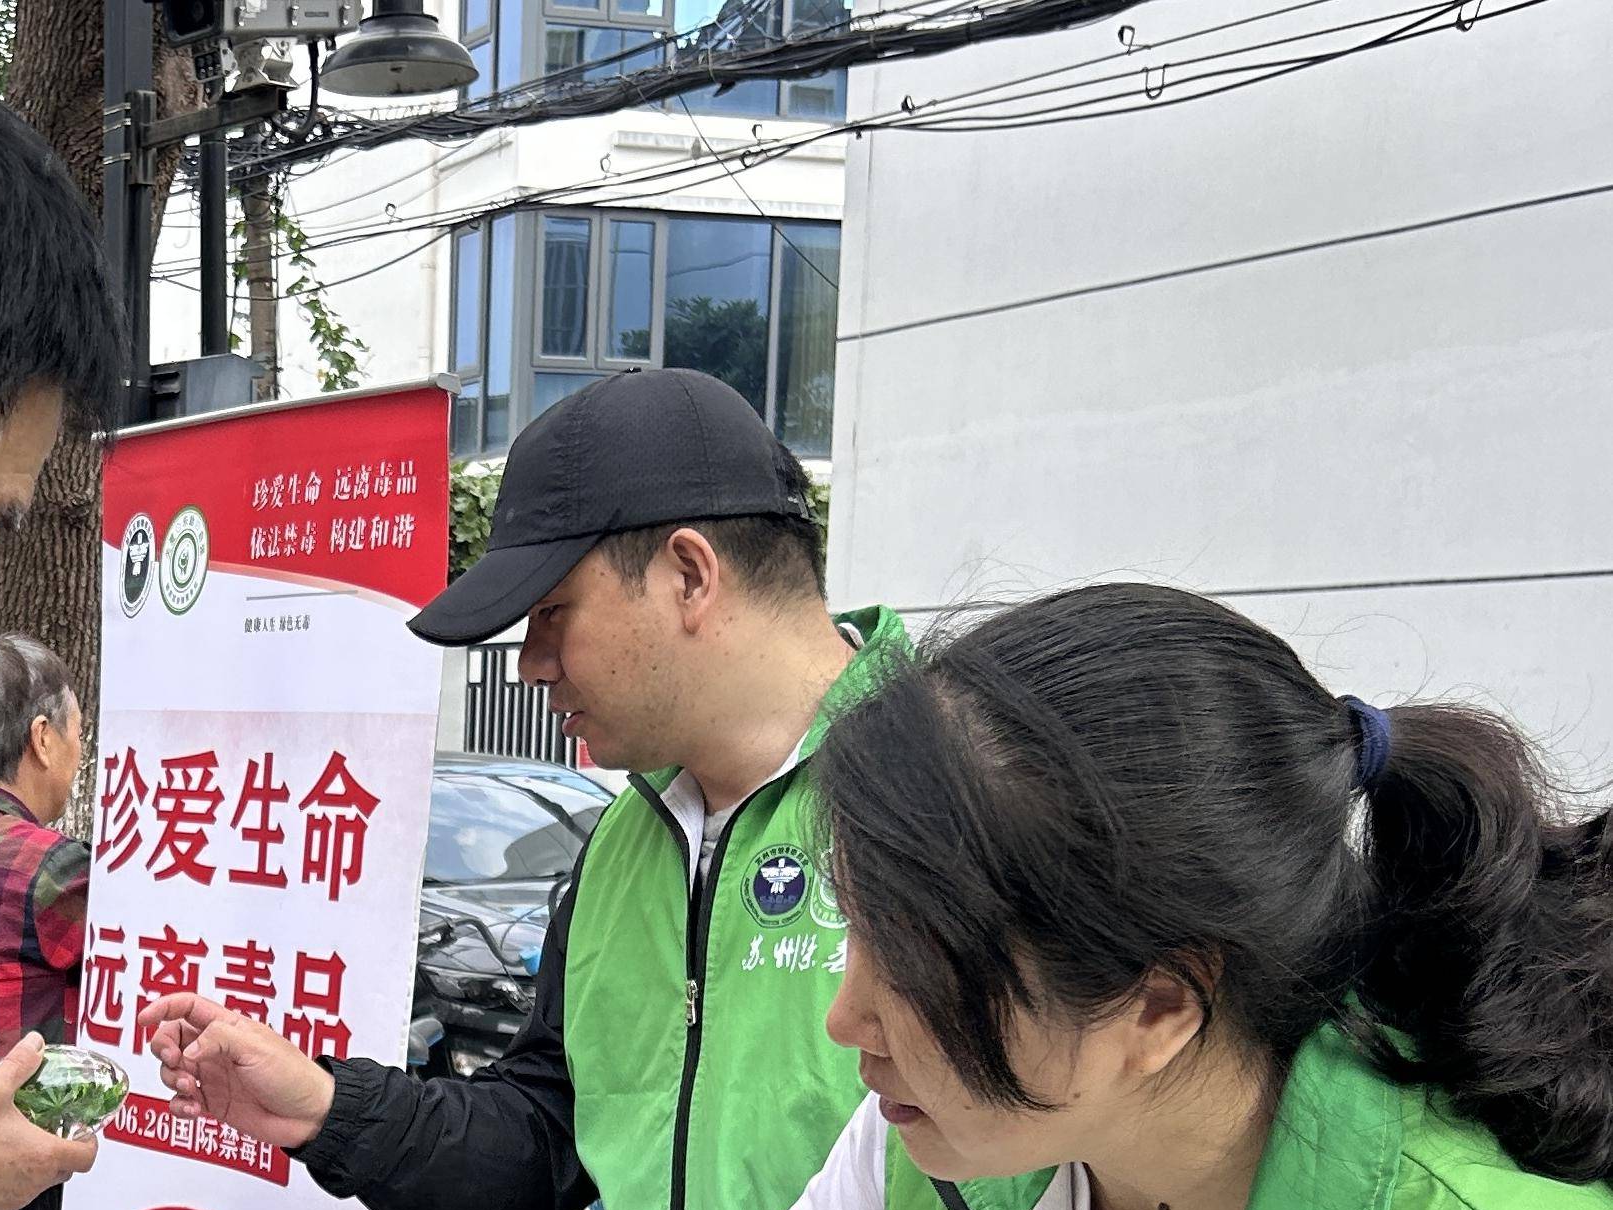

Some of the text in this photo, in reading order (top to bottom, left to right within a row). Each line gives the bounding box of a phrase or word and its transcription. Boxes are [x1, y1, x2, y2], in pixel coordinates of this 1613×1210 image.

[252, 460, 417, 511] 珍爱生命 远离毒品
[250, 520, 317, 560] 依法禁毒
[330, 513, 415, 554] 构建和谐
[95, 746, 381, 901] 珍爱生命
[115, 1104, 273, 1172] 06.26国际禁毒日
